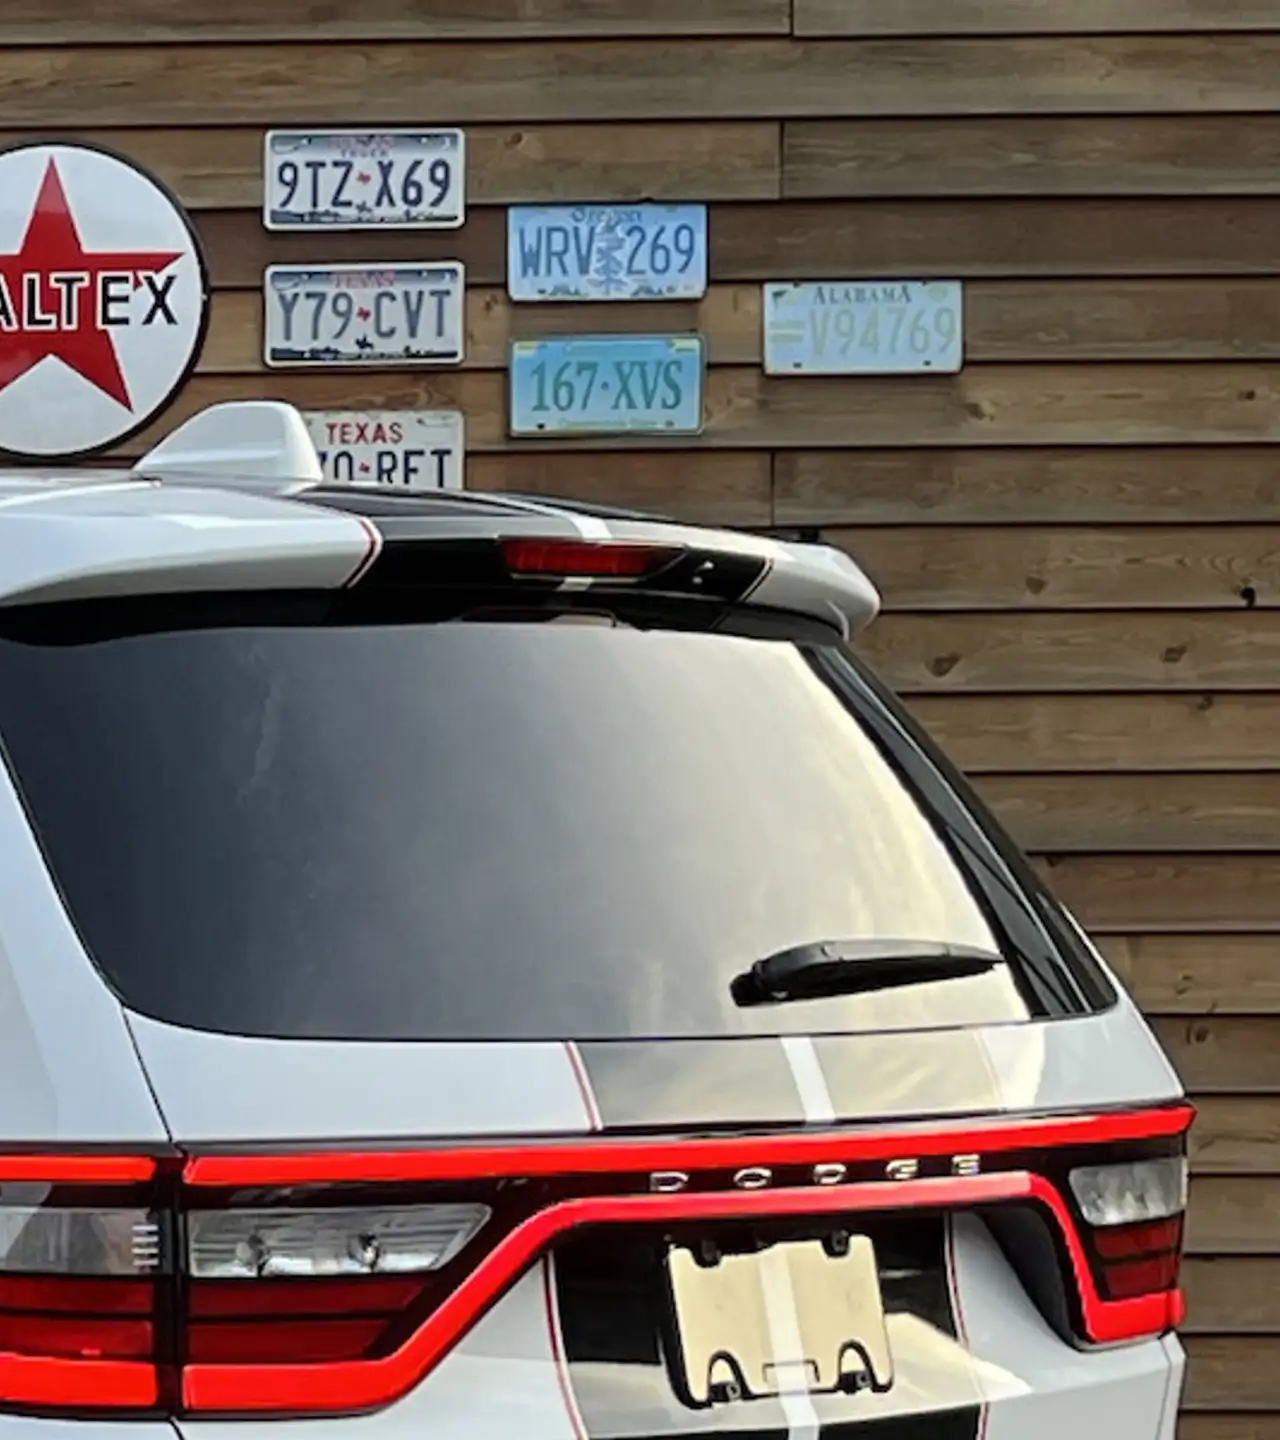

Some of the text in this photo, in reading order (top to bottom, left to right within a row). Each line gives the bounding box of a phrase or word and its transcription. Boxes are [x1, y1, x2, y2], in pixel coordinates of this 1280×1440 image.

[812, 285, 913, 305] ALABAMA
[325, 422, 404, 445] TEXAS
[649, 1153, 981, 1193] DODGE
